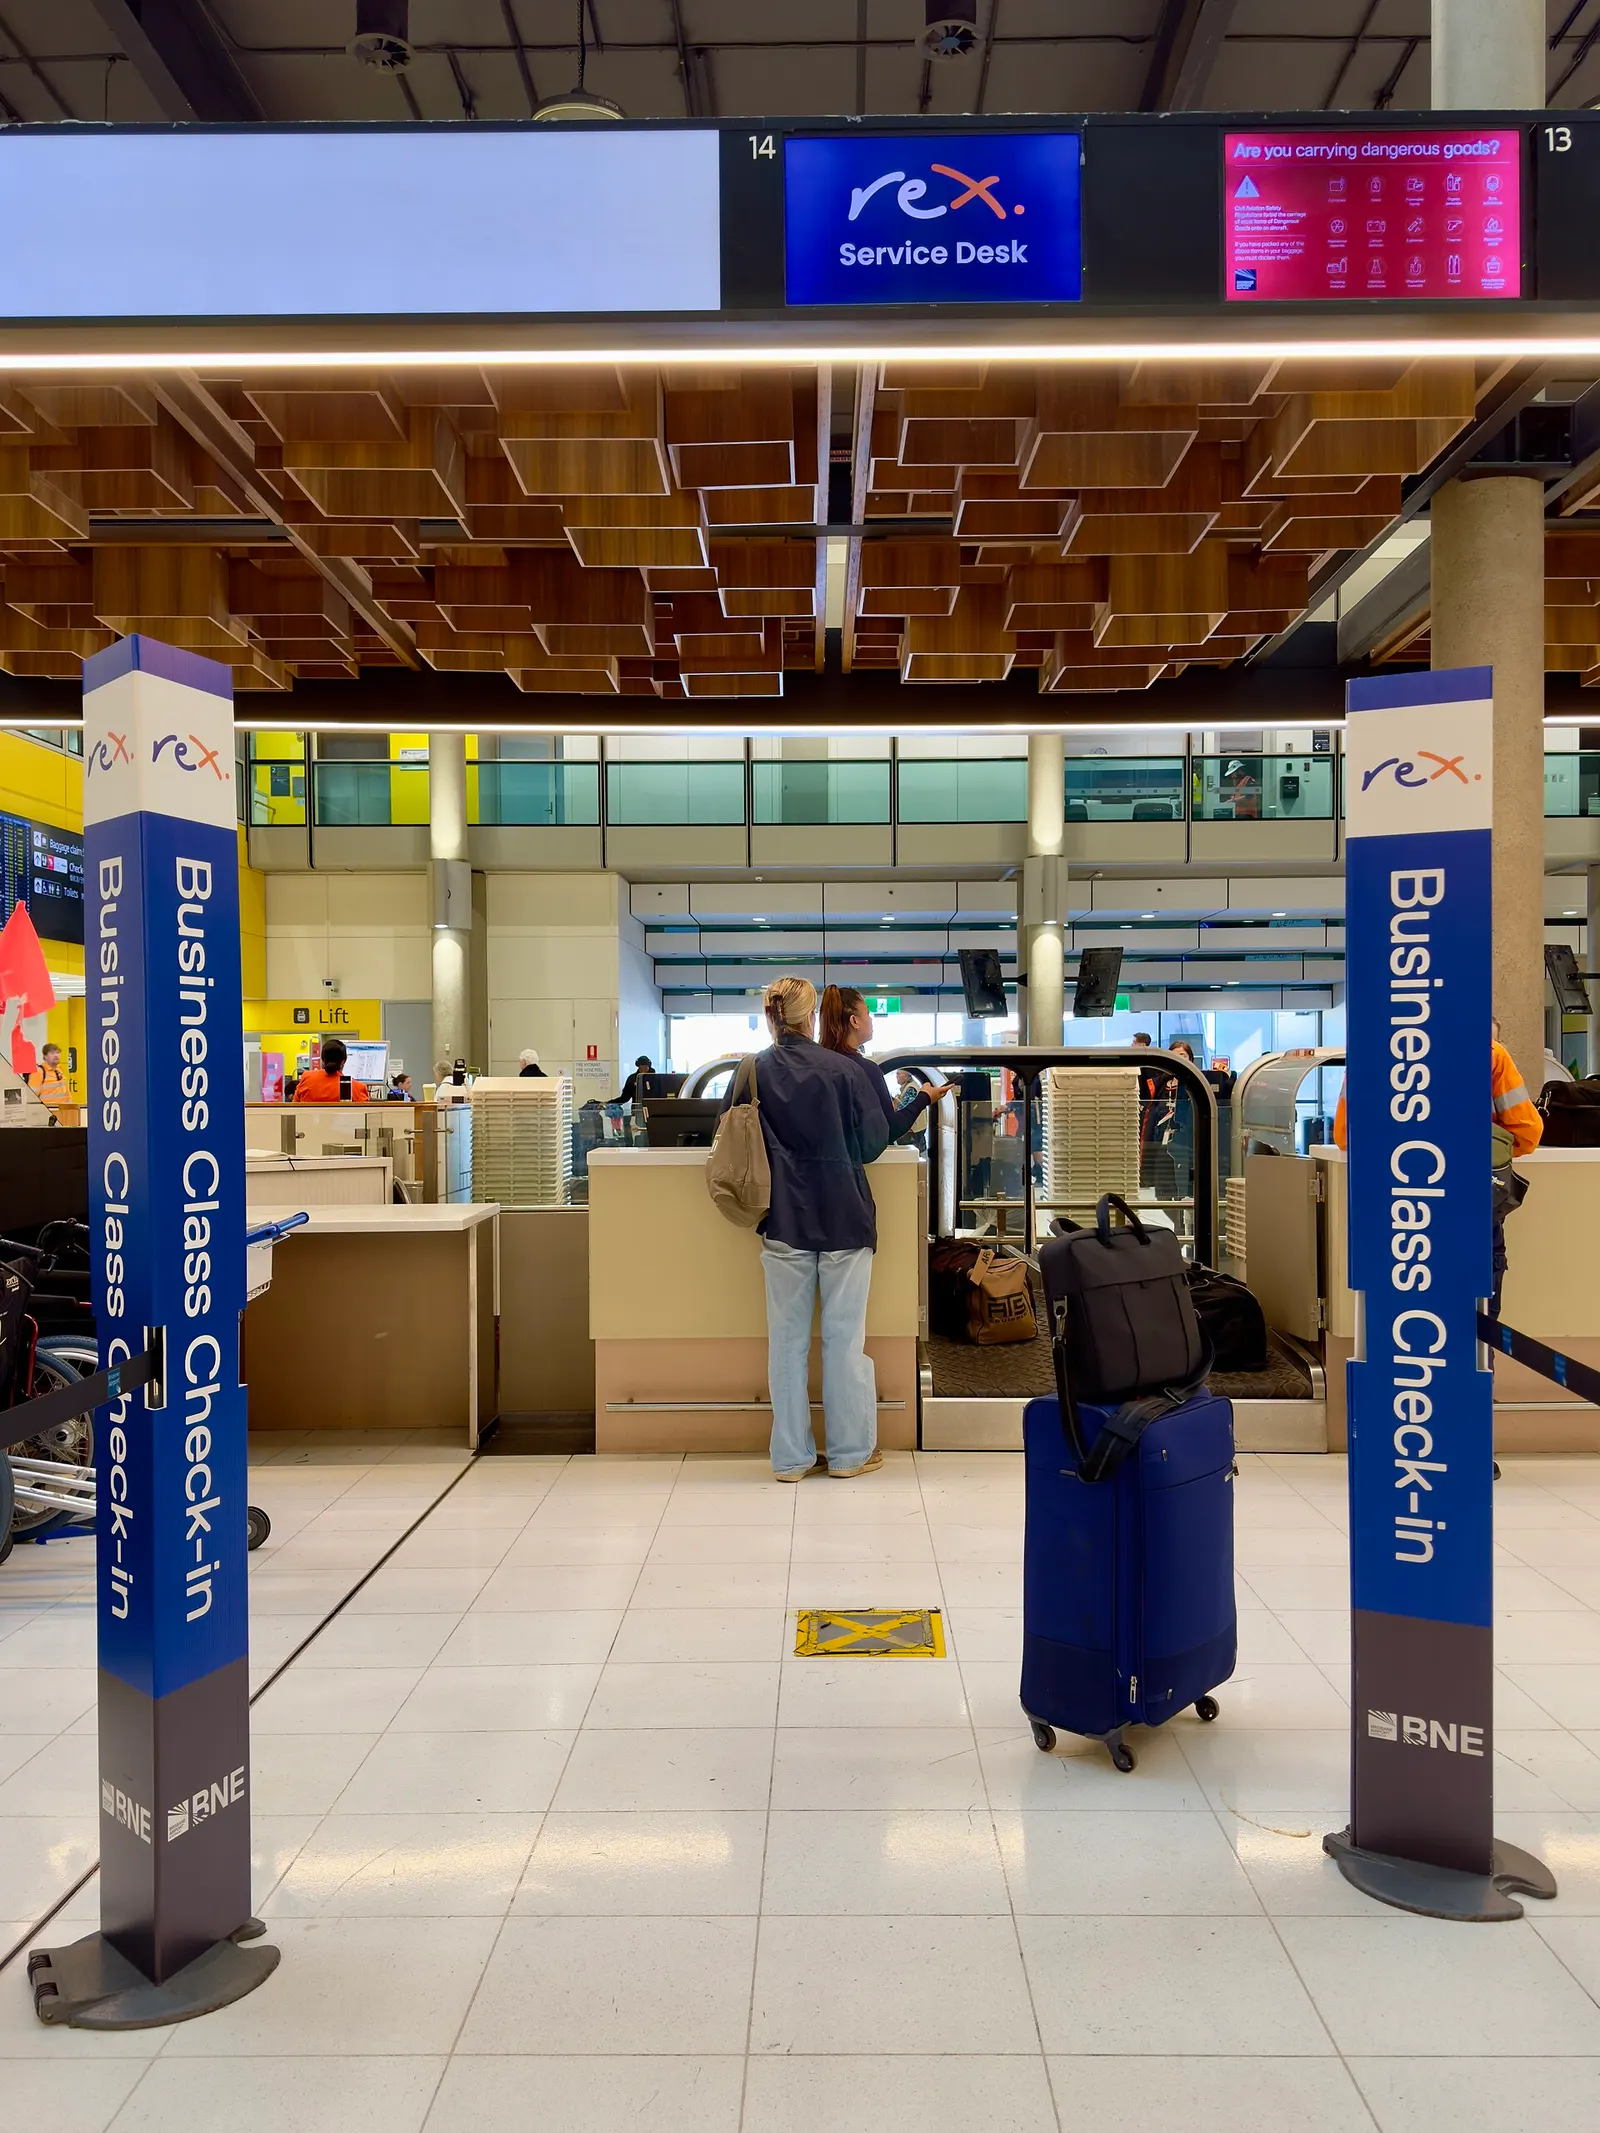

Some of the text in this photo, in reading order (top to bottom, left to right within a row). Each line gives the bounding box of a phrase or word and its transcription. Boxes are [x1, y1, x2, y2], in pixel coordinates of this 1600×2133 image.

[749, 135, 776, 160] 14
[1234, 140, 1500, 160] Are you carrying dangerous goods?
[1544, 126, 1572, 152] 13
[839, 239, 1028, 266] Service Desk
[49, 838, 83, 856] Baggage claim
[63, 886, 79, 899] Toilets
[99, 855, 124, 1132] Business
[319, 1007, 349, 1024] Lift
[1389, 868, 1448, 1563] Business Class Check-in
[104, 1151, 129, 1318] Class
[176, 856, 221, 1623] Business Class Check-in
[1402, 1715, 1484, 1757] BNE
[192, 1765, 245, 1827] BNE
[116, 1788, 151, 1845] BNE
